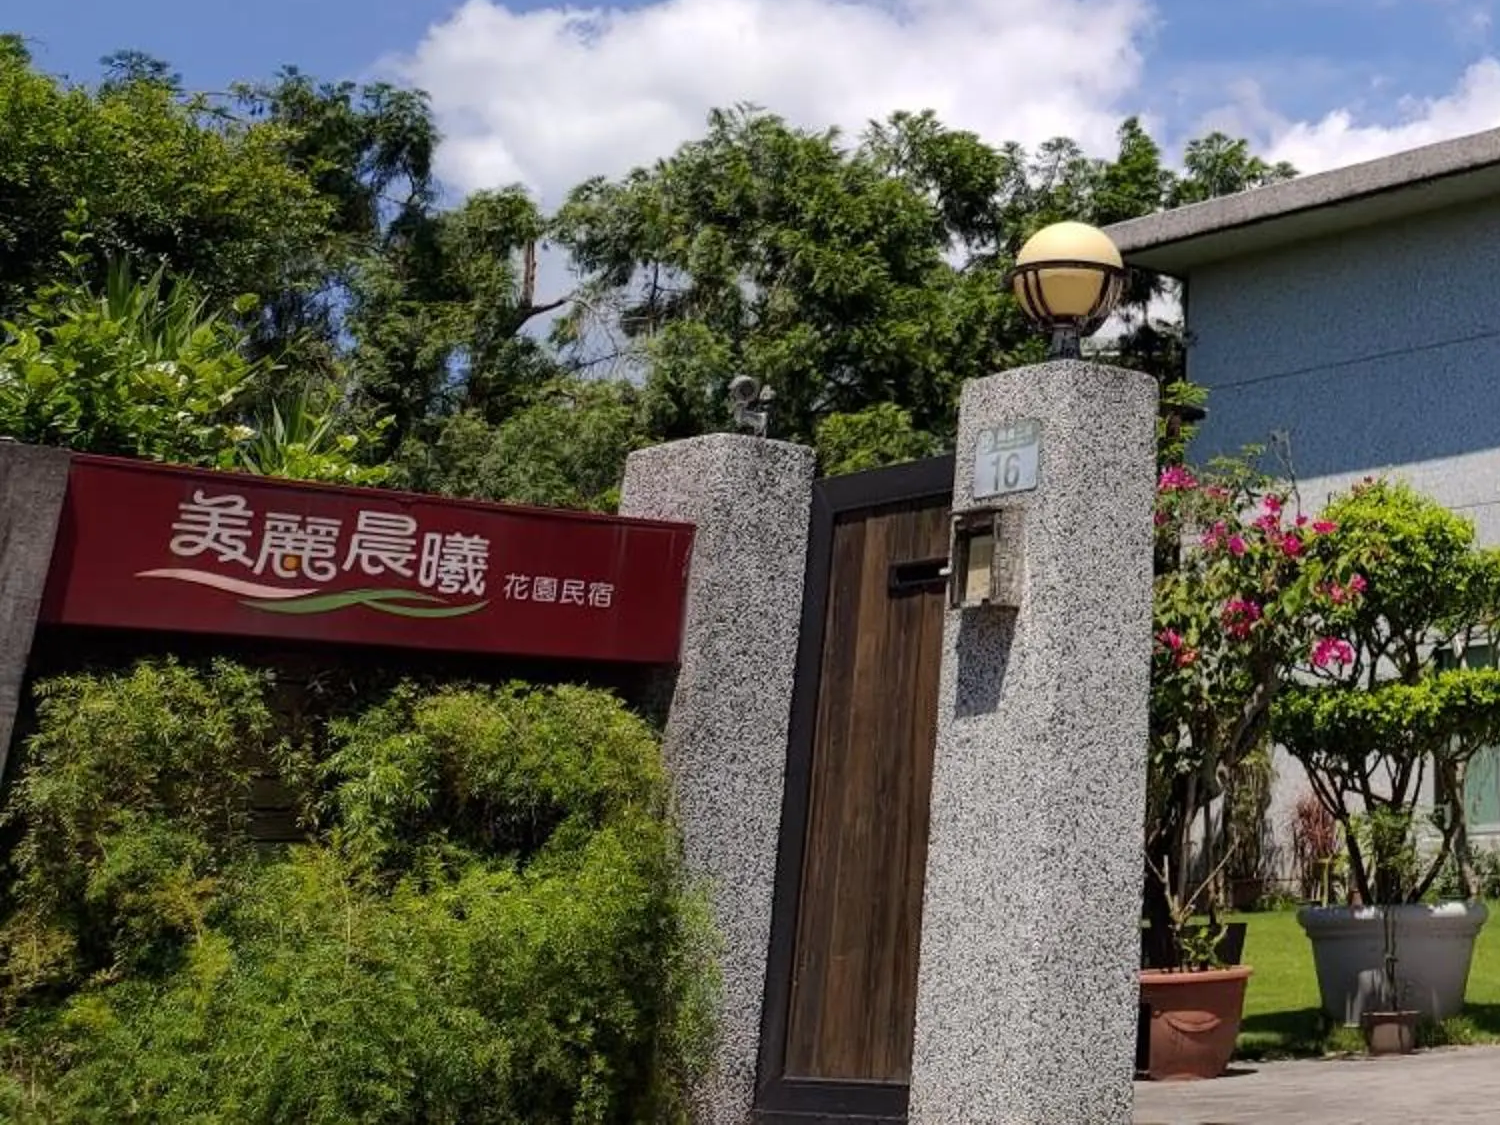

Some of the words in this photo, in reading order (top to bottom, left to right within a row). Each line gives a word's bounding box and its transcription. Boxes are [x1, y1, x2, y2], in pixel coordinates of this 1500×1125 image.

[991, 452, 1020, 491] 16
[169, 490, 490, 596] 美麗晨曦
[503, 572, 613, 608] 花園民宿
